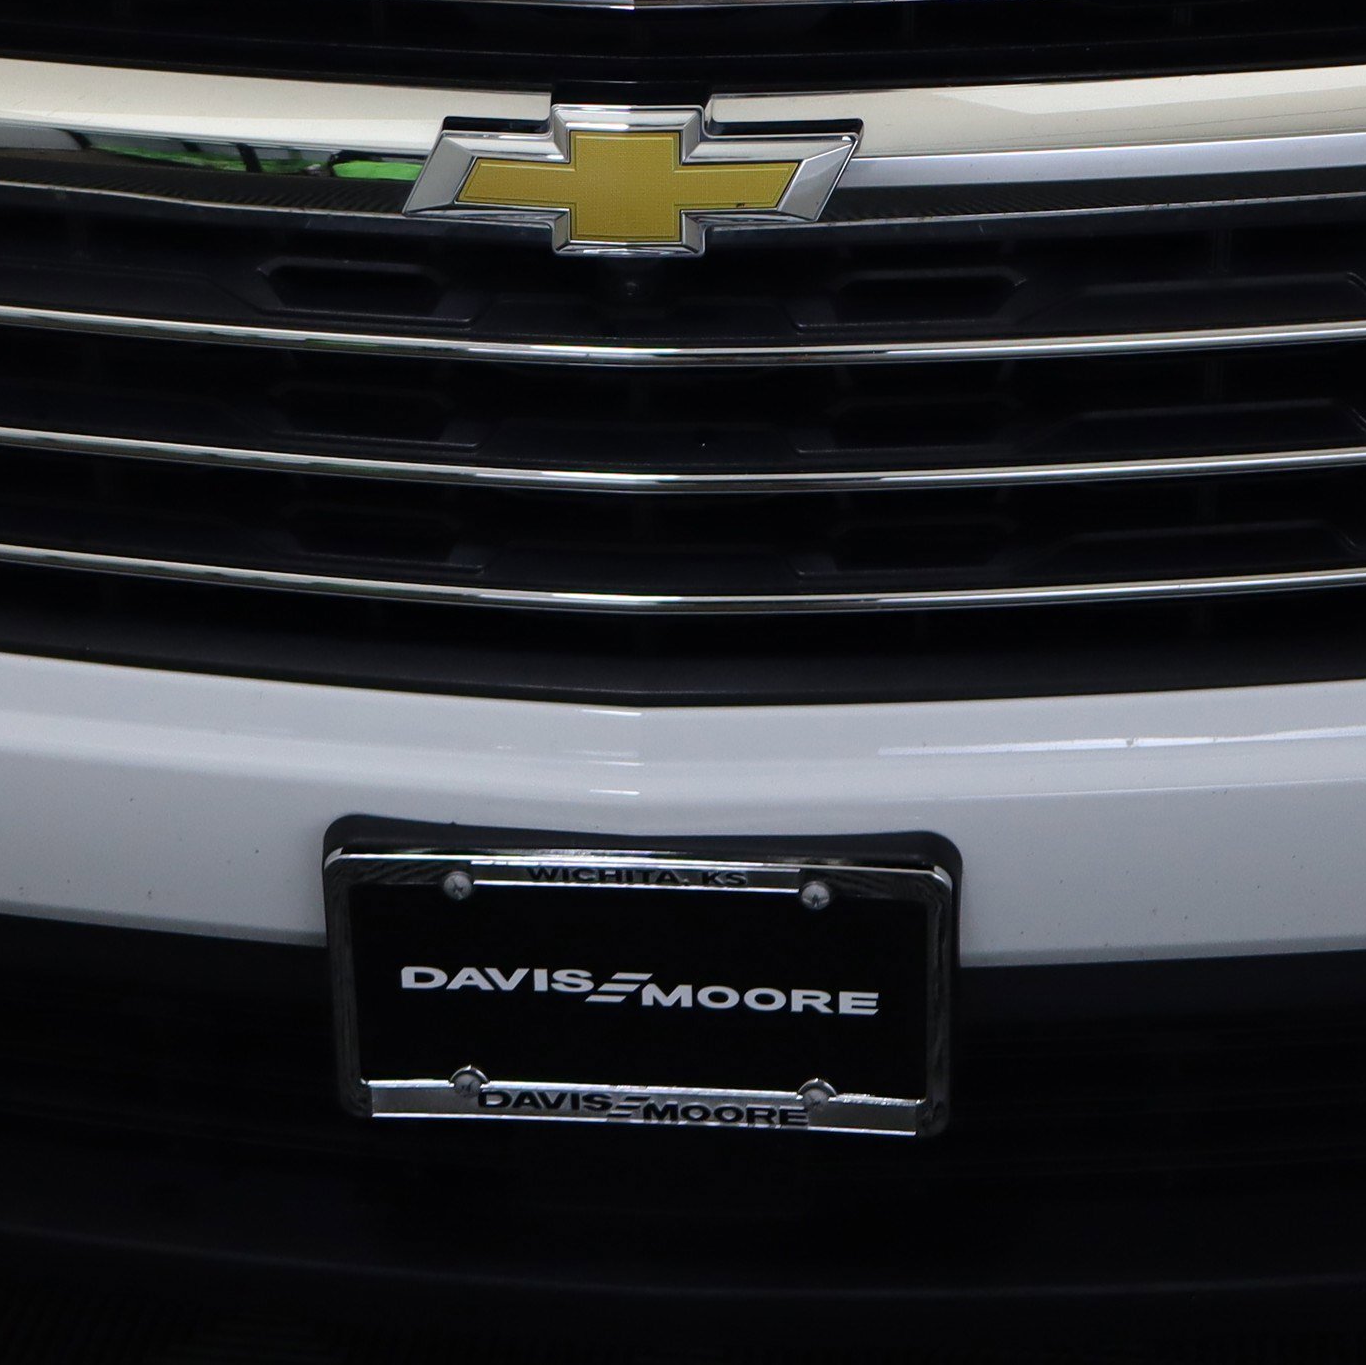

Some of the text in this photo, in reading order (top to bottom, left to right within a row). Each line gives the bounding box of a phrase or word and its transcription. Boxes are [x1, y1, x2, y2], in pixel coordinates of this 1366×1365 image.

[701, 871, 749, 887] KS
[401, 966, 879, 1015] DAVIS MOORE
[477, 1090, 809, 1127] DAVIS MOORE
